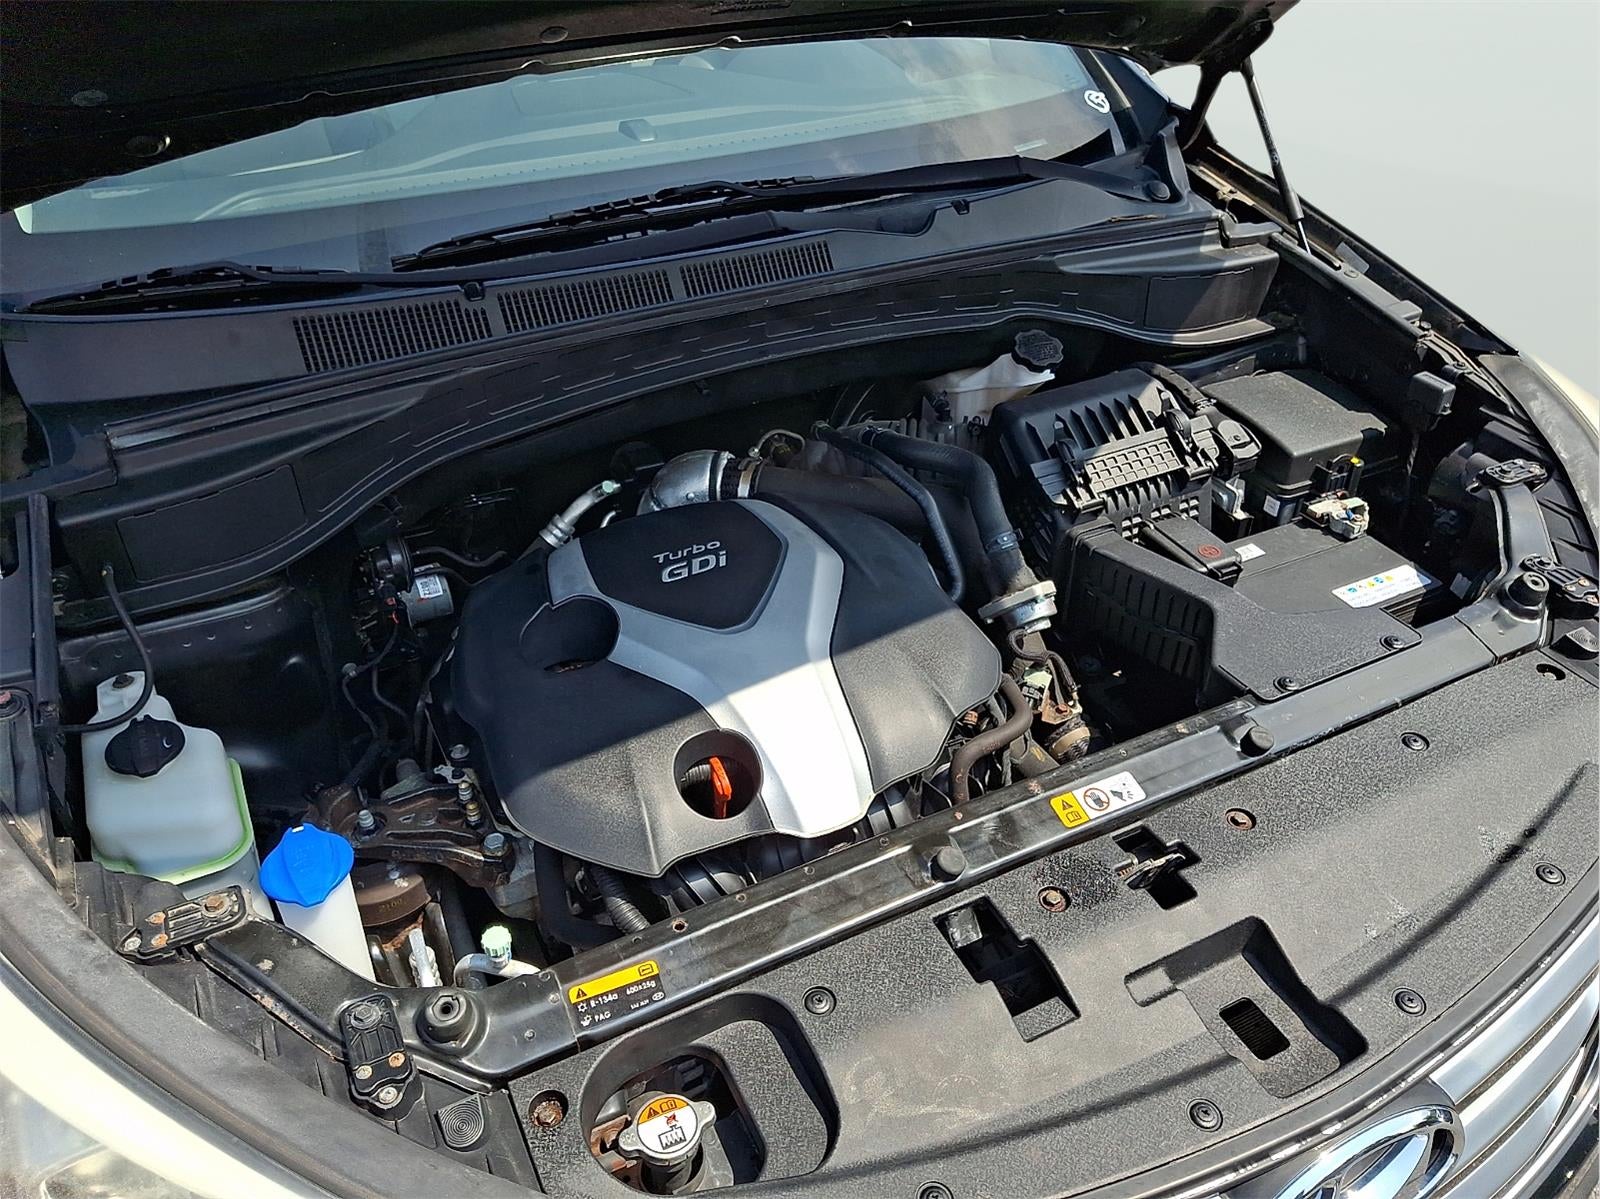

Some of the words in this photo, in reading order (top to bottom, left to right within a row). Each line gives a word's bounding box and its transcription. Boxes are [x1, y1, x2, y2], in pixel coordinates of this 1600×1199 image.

[652, 541, 721, 563] Turbo
[661, 550, 727, 582] GDi
[590, 993, 619, 1008] R-134a
[594, 1011, 611, 1022] PAG
